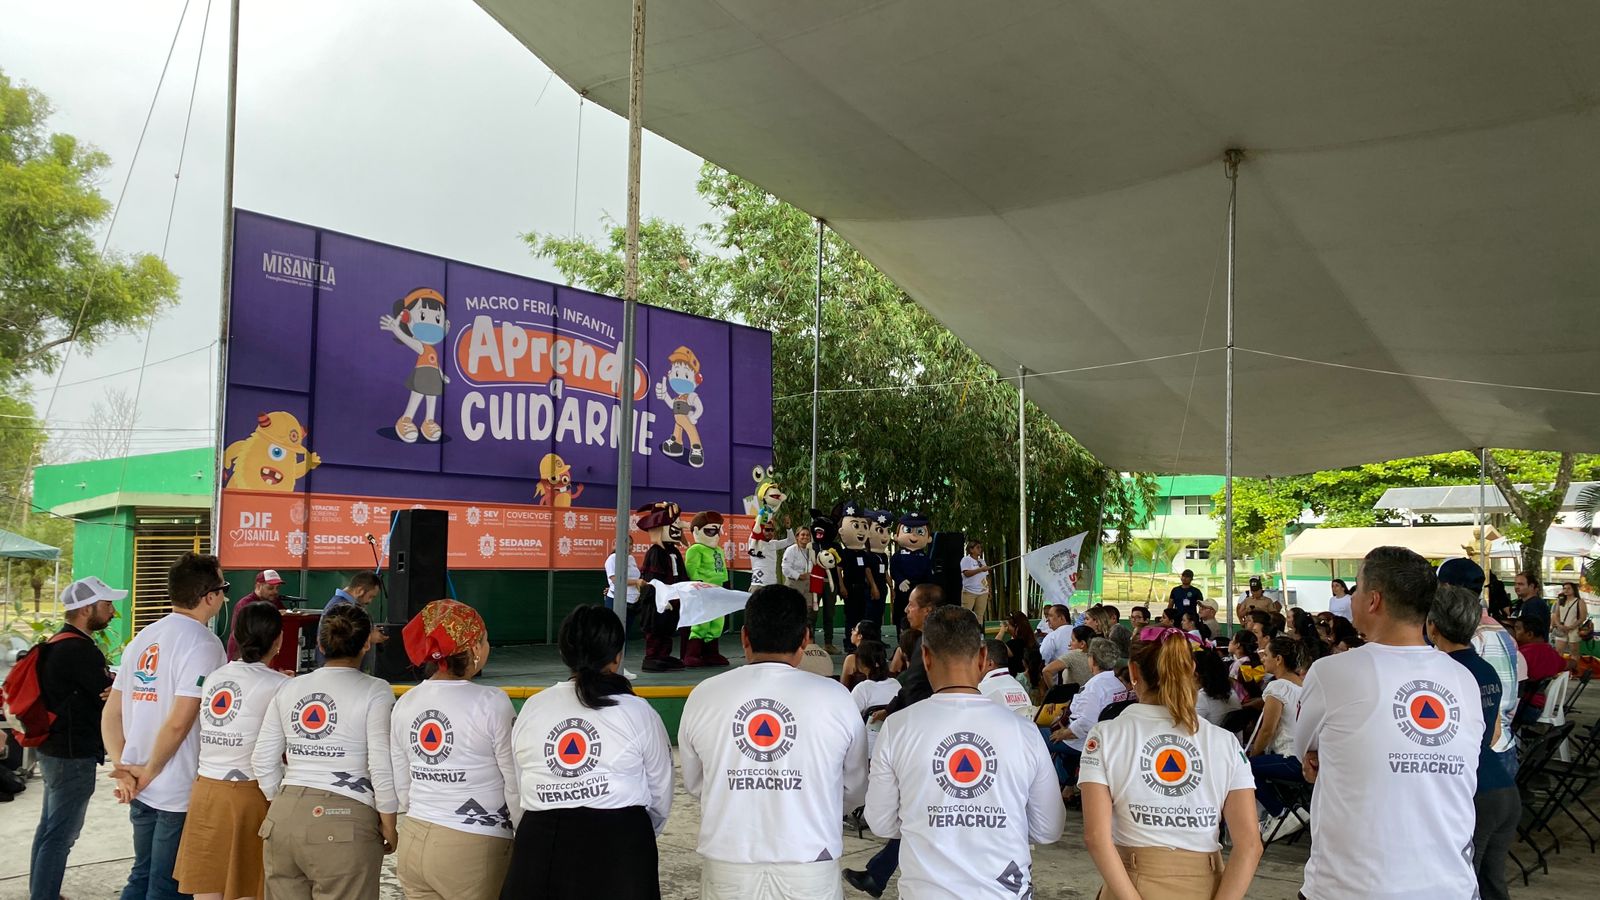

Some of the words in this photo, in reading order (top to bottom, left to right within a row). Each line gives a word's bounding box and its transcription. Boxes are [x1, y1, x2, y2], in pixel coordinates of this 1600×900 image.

[263, 252, 336, 286] MISANTLA
[465, 296, 519, 311] MACRO
[523, 298, 560, 318] FERIA
[562, 307, 616, 341] INFANTIL
[550, 378, 563, 399] a
[373, 506, 387, 514] PC
[483, 510, 499, 518] SEV
[240, 511, 273, 529] DIF
[313, 534, 366, 545] SEDESOL
[499, 538, 543, 548] SEDARPA
[573, 538, 604, 546] SECTUR
[738, 542, 749, 552] DI
[201, 735, 244, 747] ERACRUZ
[1388, 752, 1446, 761] PROTECCIÓN
[1447, 754, 1465, 763] CIVIL
[727, 767, 779, 777] PROTECCIÓN
[781, 769, 803, 777] CIVIL
[1389, 761, 1465, 776] VERACRUZ
[536, 781, 585, 791] PROTECCIÓN
[586, 775, 609, 786] CIVIL
[728, 777, 803, 791] VERACRUZ
[537, 783, 610, 803] VERACRUZ
[927, 803, 982, 814] PROTECCIÓN
[983, 805, 1007, 815] CIVIL
[1128, 804, 1191, 815] PROTECCIÓN
[1195, 807, 1217, 815] CIVIL
[928, 814, 1007, 829] VERACRUZ
[1130, 810, 1217, 828] VERACRUZ
